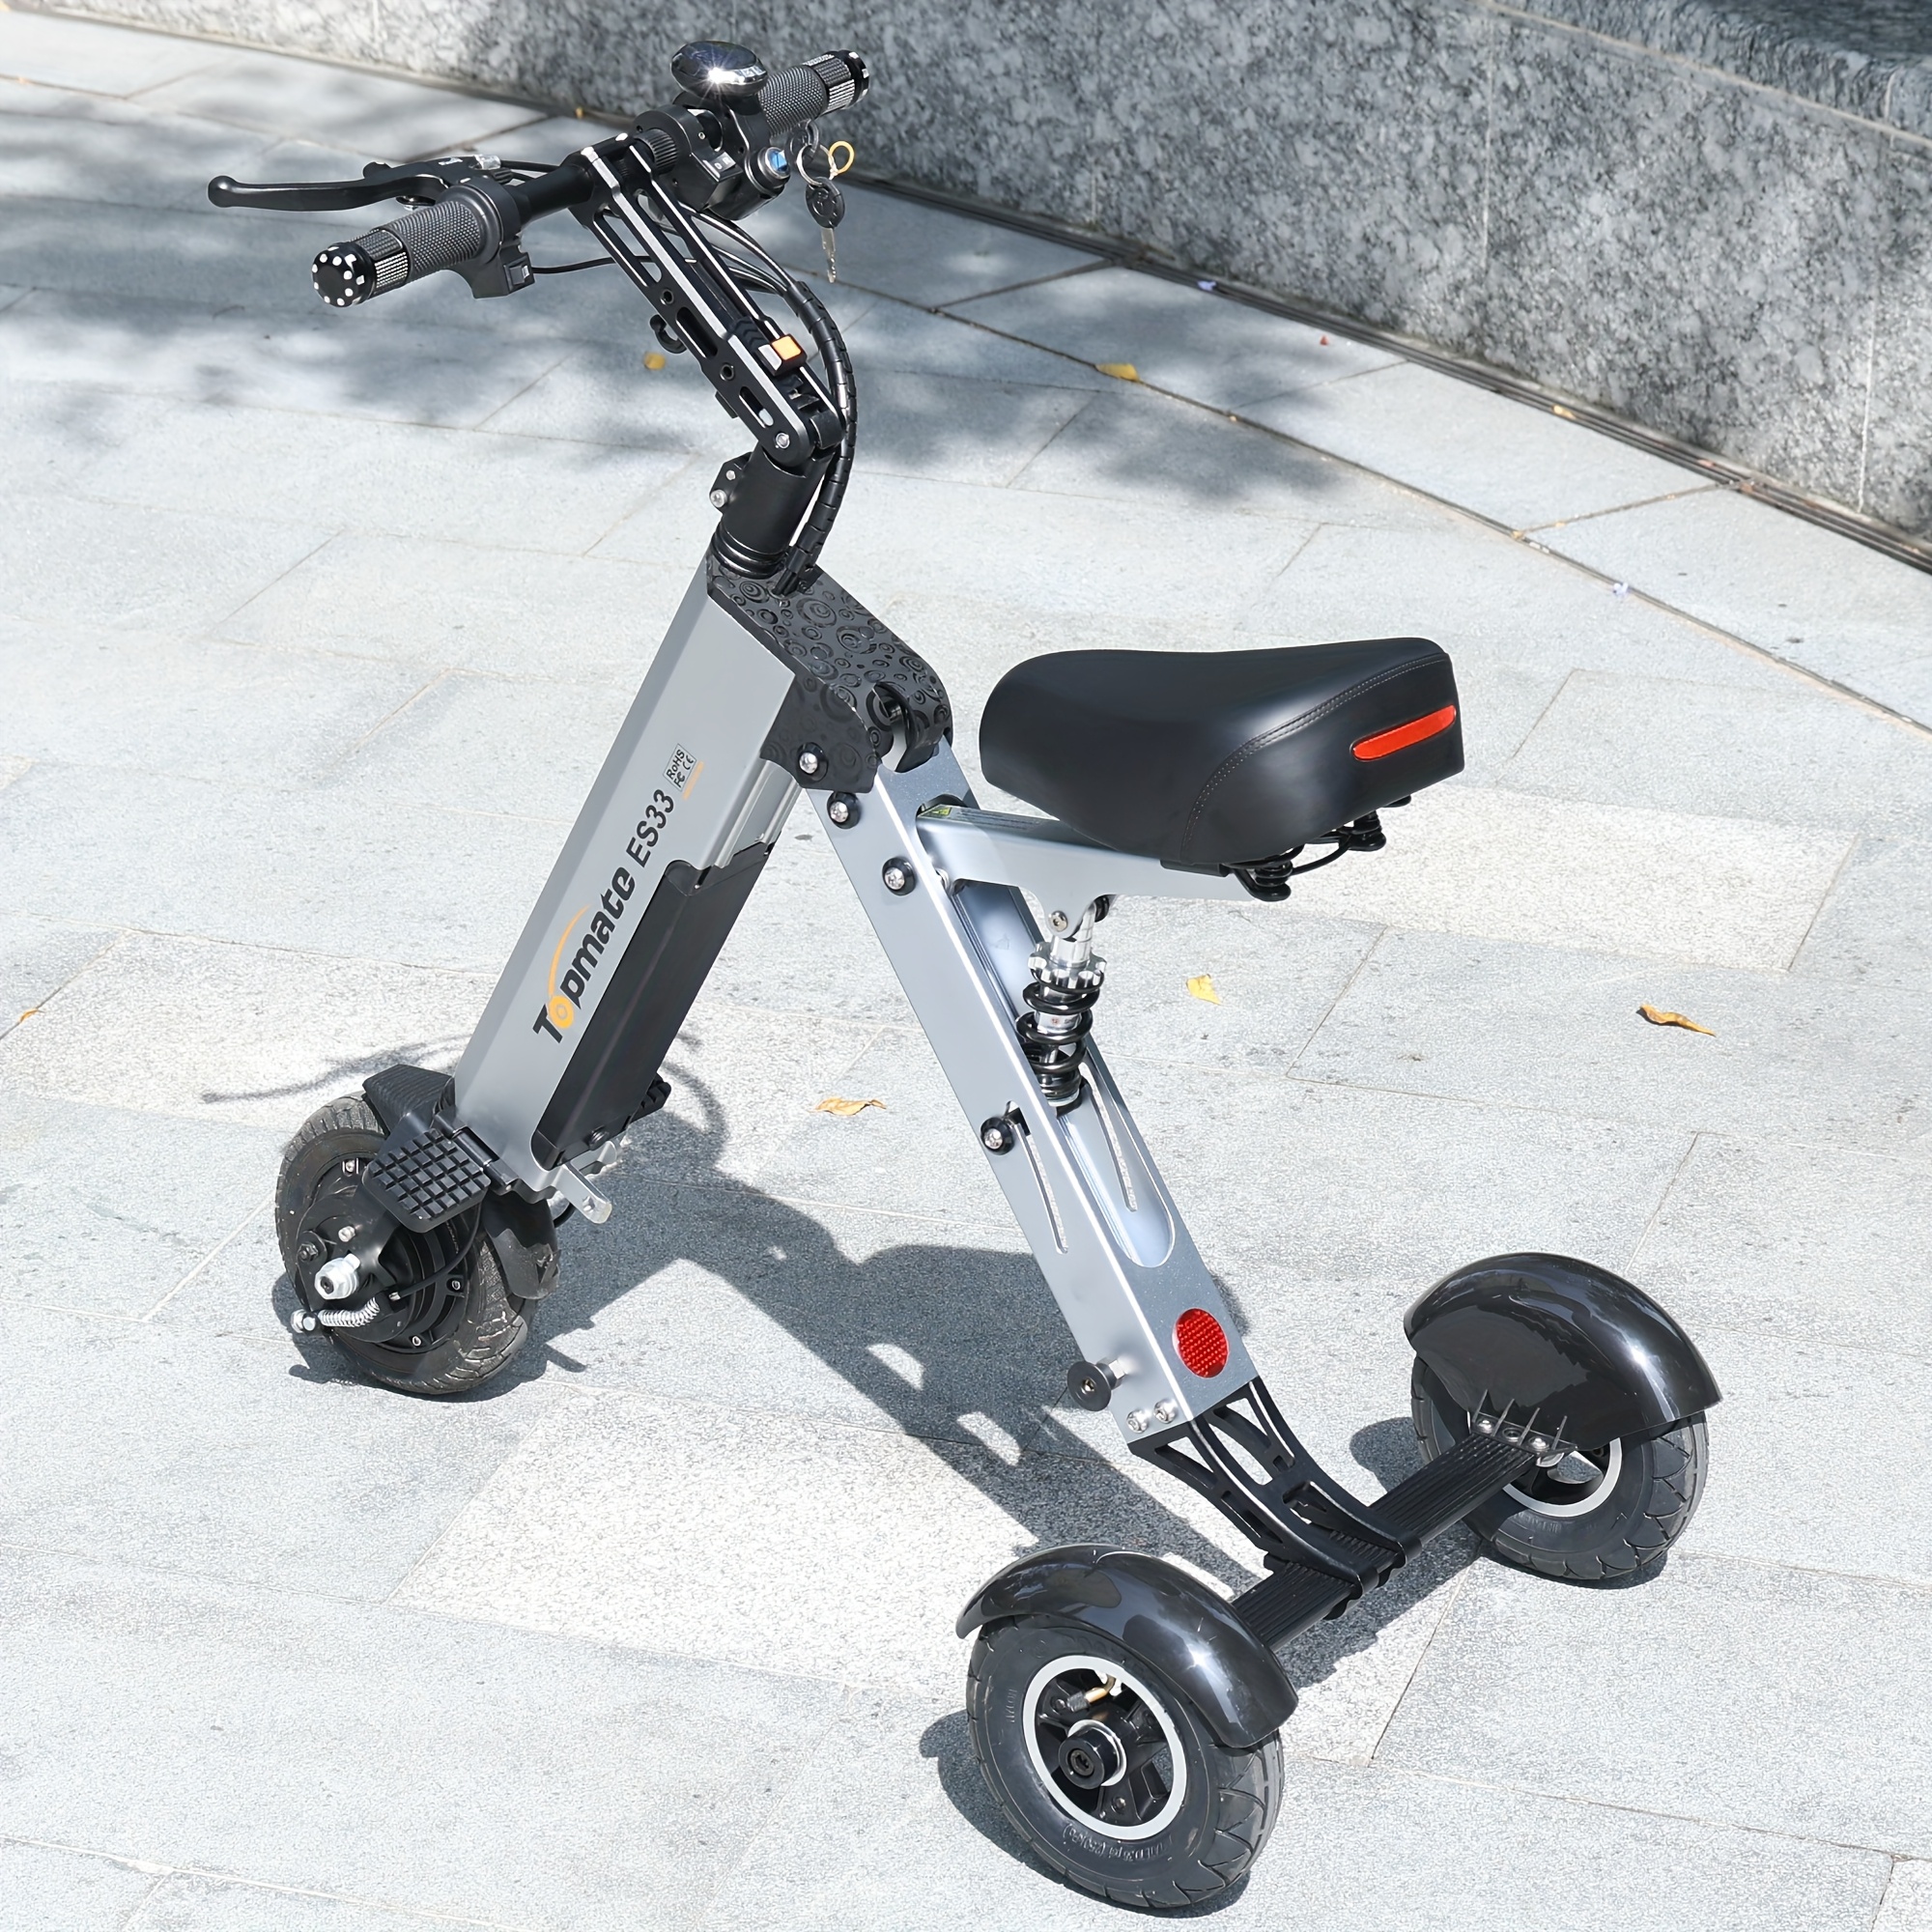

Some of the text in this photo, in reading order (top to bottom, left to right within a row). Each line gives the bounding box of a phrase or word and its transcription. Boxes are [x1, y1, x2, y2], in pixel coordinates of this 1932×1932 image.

[666, 749, 685, 780] RoHS
[532, 789, 674, 1044] Topmate ES33
